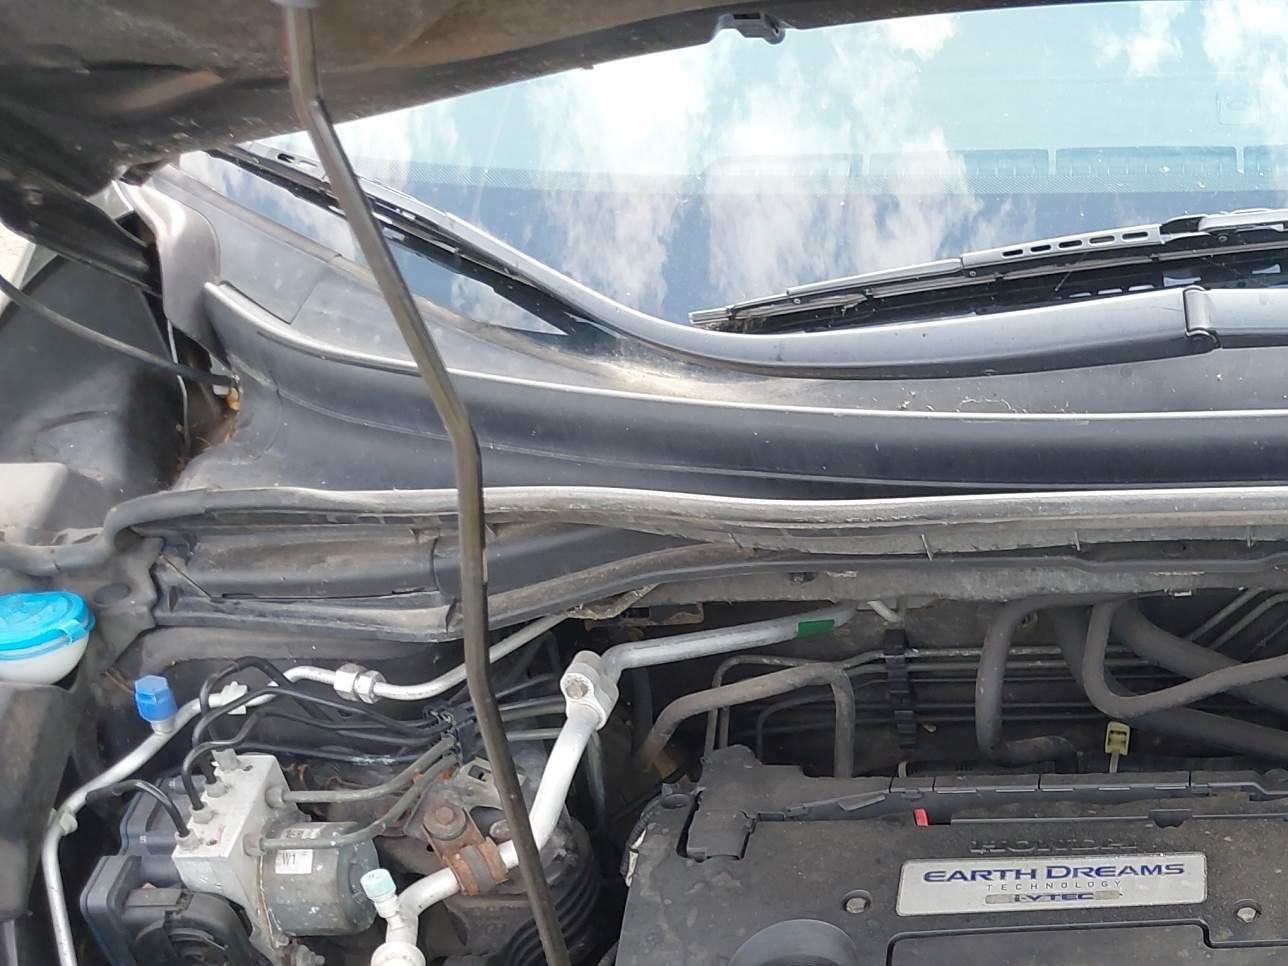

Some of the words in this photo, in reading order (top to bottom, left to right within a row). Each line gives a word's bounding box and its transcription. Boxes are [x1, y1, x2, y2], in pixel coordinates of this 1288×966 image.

[923, 867, 1037, 883] EARTH
[1046, 863, 1185, 880] DREAMS
[986, 879, 1123, 891] TECHNOLOGY
